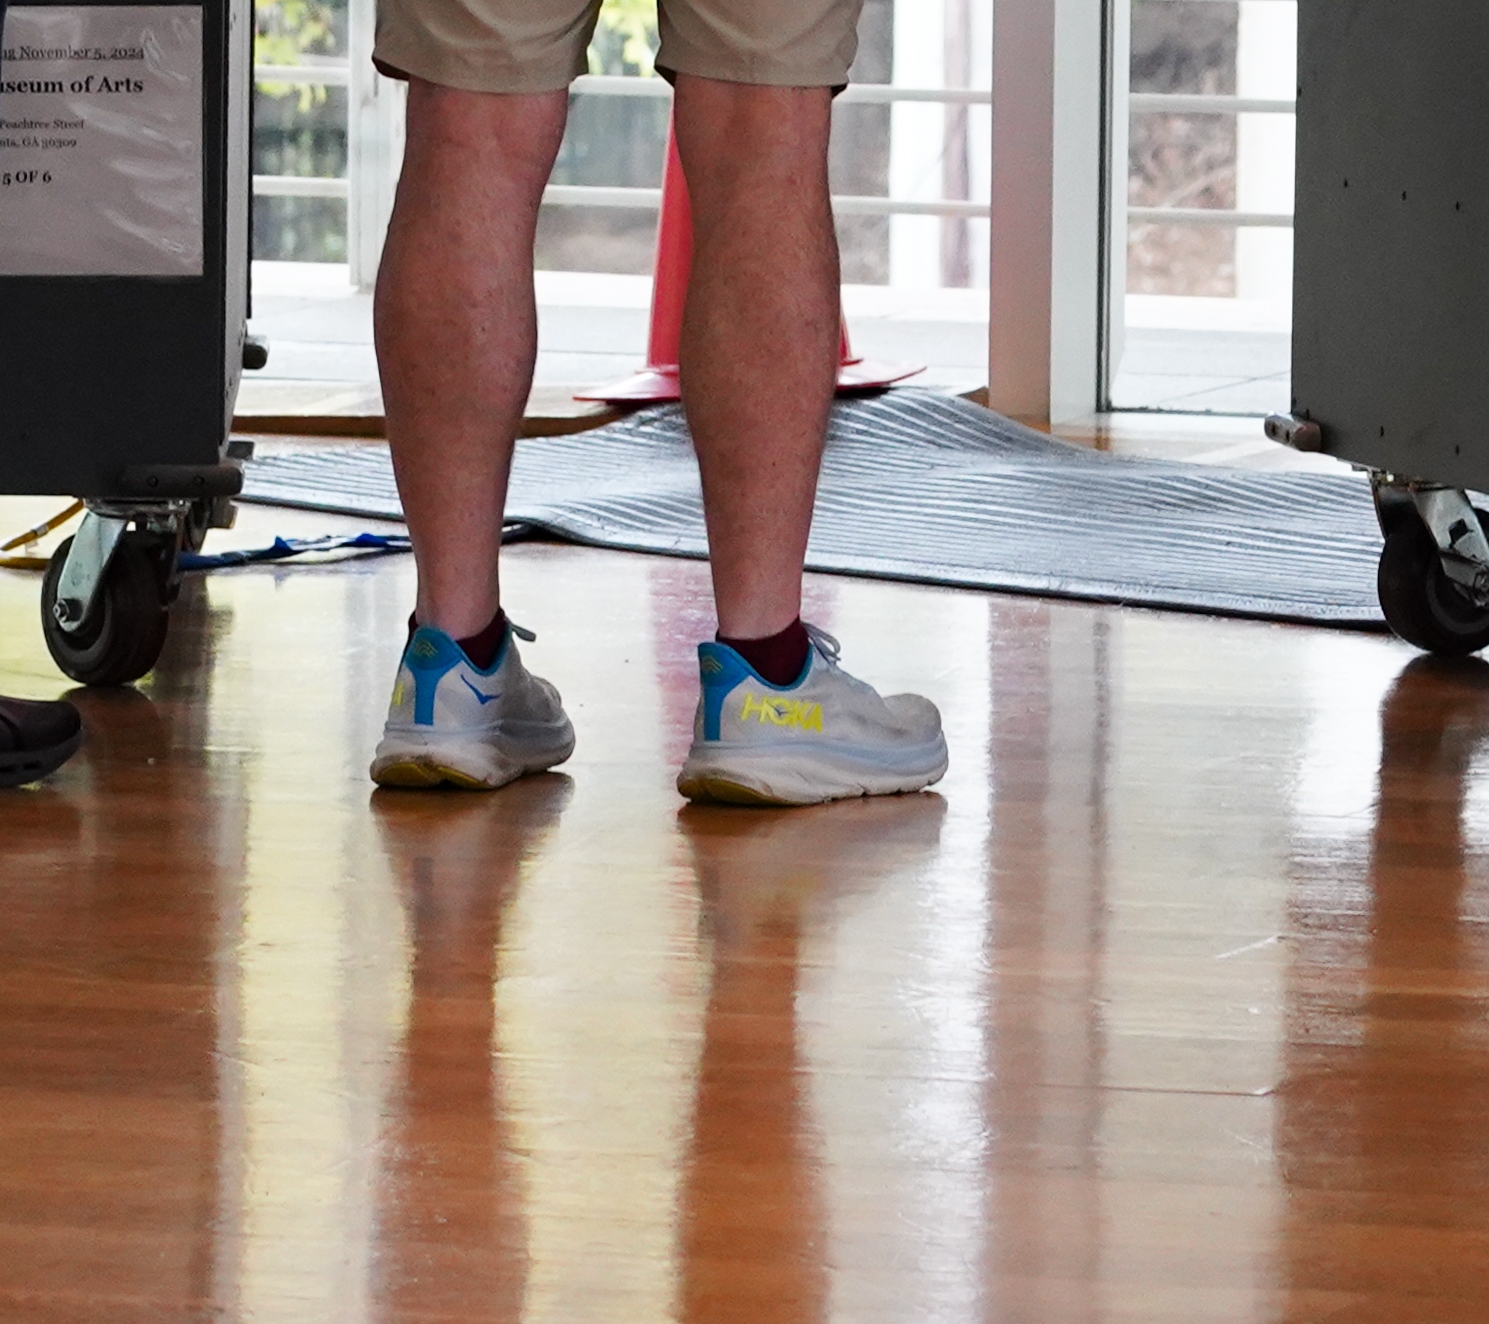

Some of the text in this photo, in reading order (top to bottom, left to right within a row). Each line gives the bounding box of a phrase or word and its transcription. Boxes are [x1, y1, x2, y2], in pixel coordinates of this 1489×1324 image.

[19, 45, 94, 60] November
[94, 48, 107, 60] 5,
[111, 47, 145, 60] 2024
[70, 75, 94, 94] of
[98, 76, 144, 94] Arts
[0, 119, 85, 130] Peachtree Street
[22, 138, 39, 147] GA
[41, 139, 77, 150] 30309
[2, 170, 52, 186] 5 OF 6
